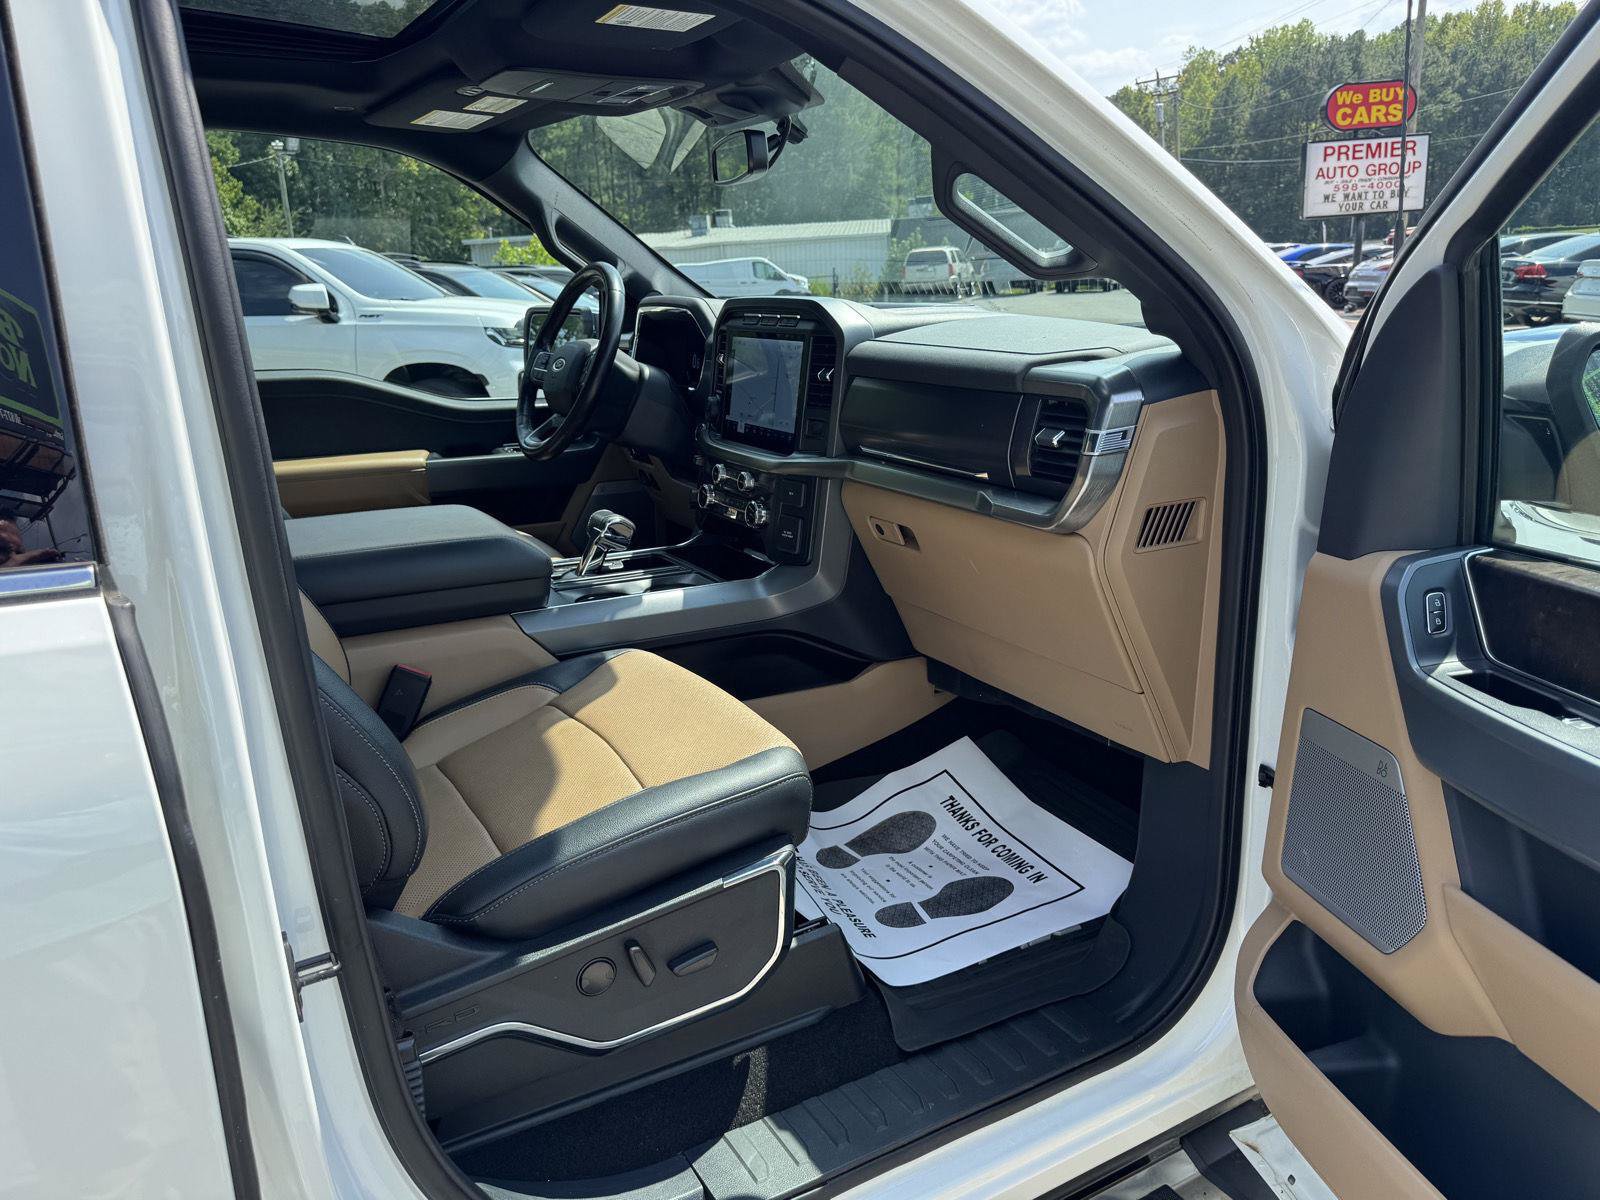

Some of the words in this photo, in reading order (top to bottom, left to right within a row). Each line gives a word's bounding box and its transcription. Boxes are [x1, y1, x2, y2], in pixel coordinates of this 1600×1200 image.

[1336, 91, 1362, 105] We
[1369, 87, 1404, 102] BUY
[1336, 104, 1402, 125] CARS
[1323, 140, 1417, 162] PREMIER
[1315, 165, 1359, 180] AUTO
[1366, 161, 1422, 176] GROUP
[1323, 193, 1337, 203] WE
[1343, 191, 1369, 201] WANT
[1372, 190, 1385, 200] TO
[1338, 203, 1364, 212] YOUR
[1369, 200, 1388, 210] CAR
[939, 794, 980, 831] THANKS
[971, 828, 998, 848] FOR
[991, 844, 1034, 875] COMING
[1026, 871, 1048, 884] IN
[821, 898, 842, 915] YOU
[831, 898, 877, 938] PLEASURE
